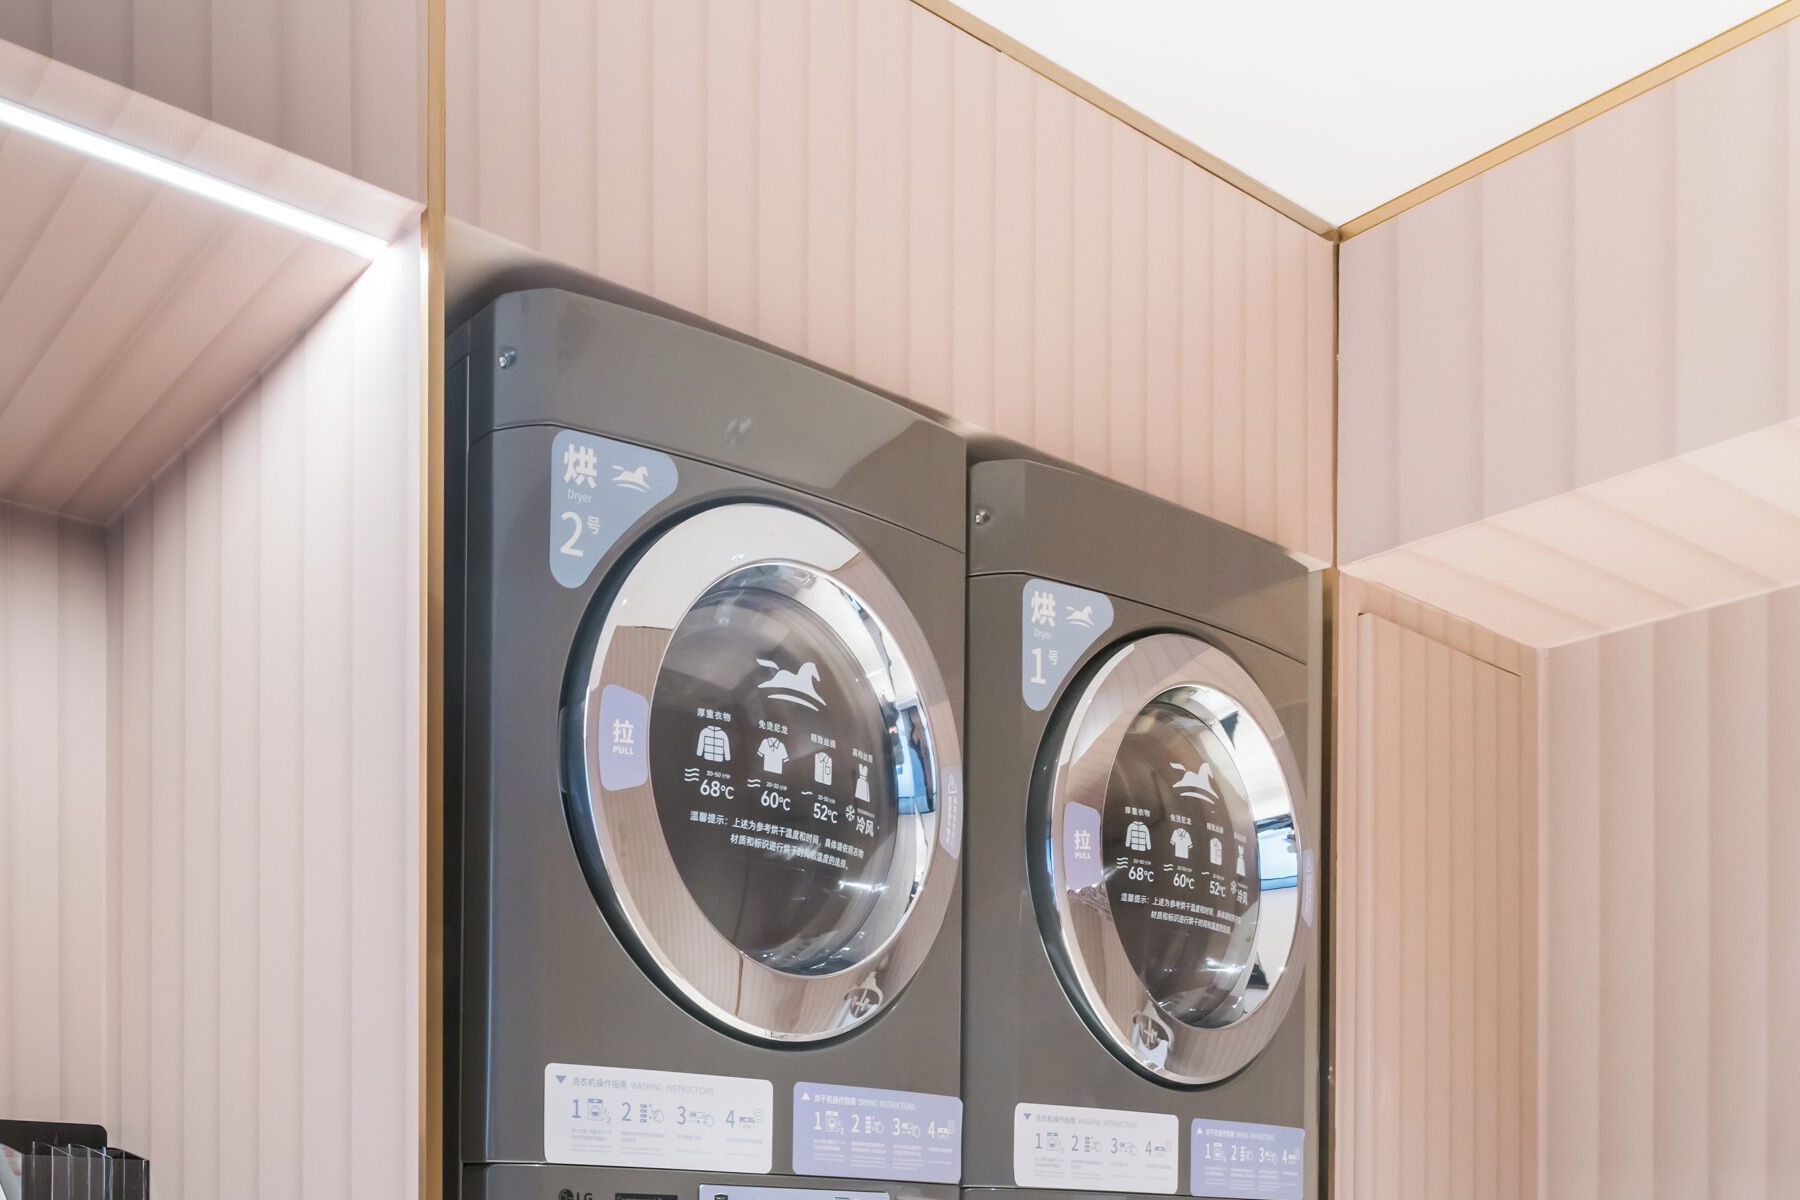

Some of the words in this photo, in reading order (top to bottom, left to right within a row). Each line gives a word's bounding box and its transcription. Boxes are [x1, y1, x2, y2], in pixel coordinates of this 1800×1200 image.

[563, 444, 597, 488] 烘
[567, 489, 592, 503] Dryer
[1031, 591, 1055, 627] 烘
[697, 707, 731, 723] 厚重衣物
[612, 719, 634, 743] 拉
[612, 745, 634, 755] PULL
[855, 816, 875, 838] 冷风
[1074, 830, 1091, 850] 拉
[571, 1099, 581, 1118] 1
[621, 1102, 632, 1122] 2
[677, 1106, 687, 1125] 3
[725, 1109, 735, 1128] 4
[814, 1111, 822, 1130] 1
[851, 1114, 860, 1133] 2
[893, 1118, 900, 1136] 3
[928, 1121, 935, 1139] 4
[1035, 1133, 1042, 1149] 1
[1071, 1135, 1079, 1151] 2
[1111, 1138, 1118, 1154] 3
[1145, 1140, 1152, 1156] 4
